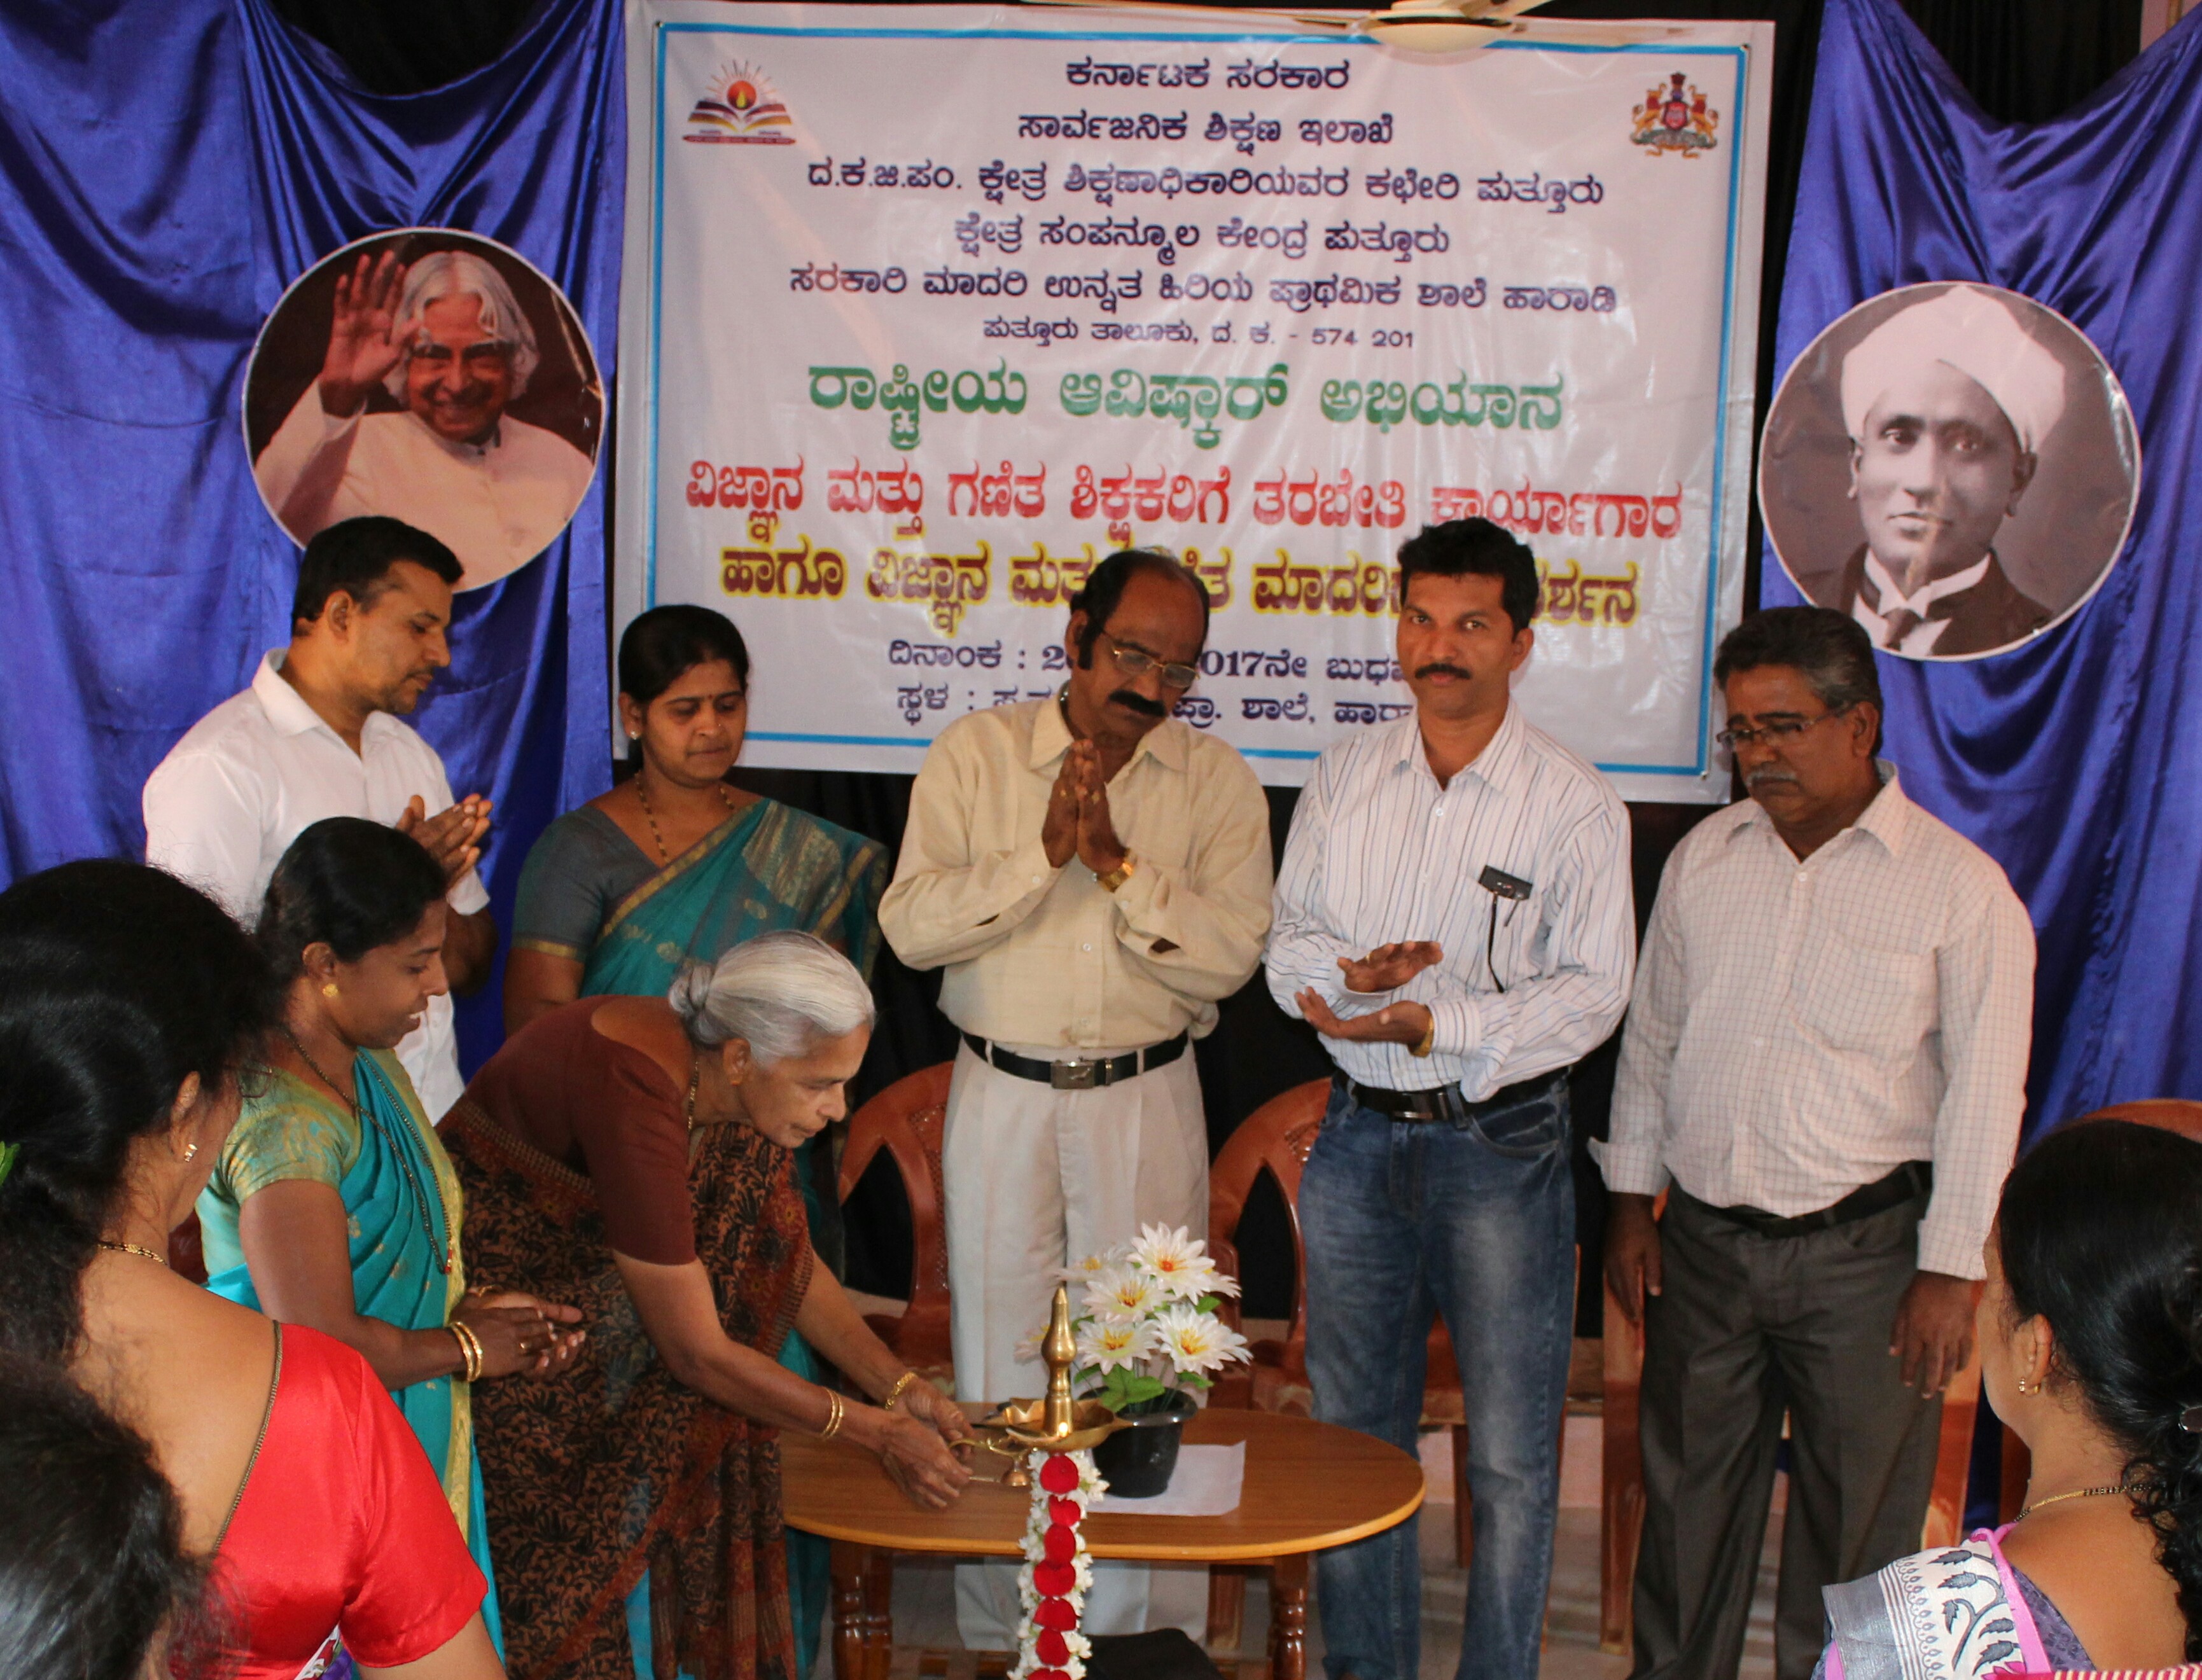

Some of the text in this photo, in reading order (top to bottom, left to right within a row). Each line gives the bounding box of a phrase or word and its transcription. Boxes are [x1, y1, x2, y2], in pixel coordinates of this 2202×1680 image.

[1066, 56, 1350, 90] ಕರ್ನಾಟಕ ಸರಕಾರ
[1018, 109, 1393, 156] ಸಾರ್ವಜನಿಕ ಶಿಕ್ಷಣ ಇಲಾಖೆ
[978, 159, 1047, 205] ಕ್ಷೇತ್ರ
[1064, 162, 1349, 207] ಶಿಕ್ಷಣಾಧಿಕಾರಿಯವರ
[1365, 167, 1460, 205] ಕಛೇರಿ
[1477, 170, 1604, 214] ಪುತ್ತೂರು
[955, 211, 1450, 267] ಕ್ಷೇತ್ರ ಸಂಪನ್ಮೂಲ ಕೇಂದ್ರ ಪುತ್ತೂರು
[790, 261, 1616, 315] ಸರಕಾರಿ ಮಾದರಿ ಉನ್ನತ ಹಿರಿಯ ಪ್ರಾಥಮಿಕ ಶಾಲೆ ಹಾರಾಡಿ
[984, 315, 1078, 347] ಪುತ್ತೂರು
[1091, 319, 1199, 345] ತಾಲೂಕು,
[1312, 328, 1358, 345] 574
[1372, 330, 1414, 348] 201
[809, 358, 1563, 452] ರಾಷ್ಟ್ರೀಯ ಆವಿಷ್ಕಾರ್ ಅಭಿಯಾನ
[686, 455, 805, 544] ವಿಜ್ಞಾನ
[828, 457, 926, 536] ಮತ್ತು
[948, 460, 1047, 518] ಗಣಿತ
[1070, 464, 1232, 550] ಶಿಕ್ಷಕರಿಗೆ
[1253, 468, 1406, 529] ತರಬೇತಿ
[720, 534, 849, 601] ಹಾಗೂ
[864, 539, 993, 638] ವಿಜ್ಞಾನ
[1008, 541, 1098, 607] ಮತ
[1251, 548, 1401, 617] ಮಾದರಿ
[889, 639, 1001, 669] ದಿನಾಂಕ
[898, 682, 949, 726] ಸ್ಥಳ
[1241, 692, 1315, 723] ಶಾಲೆ,
